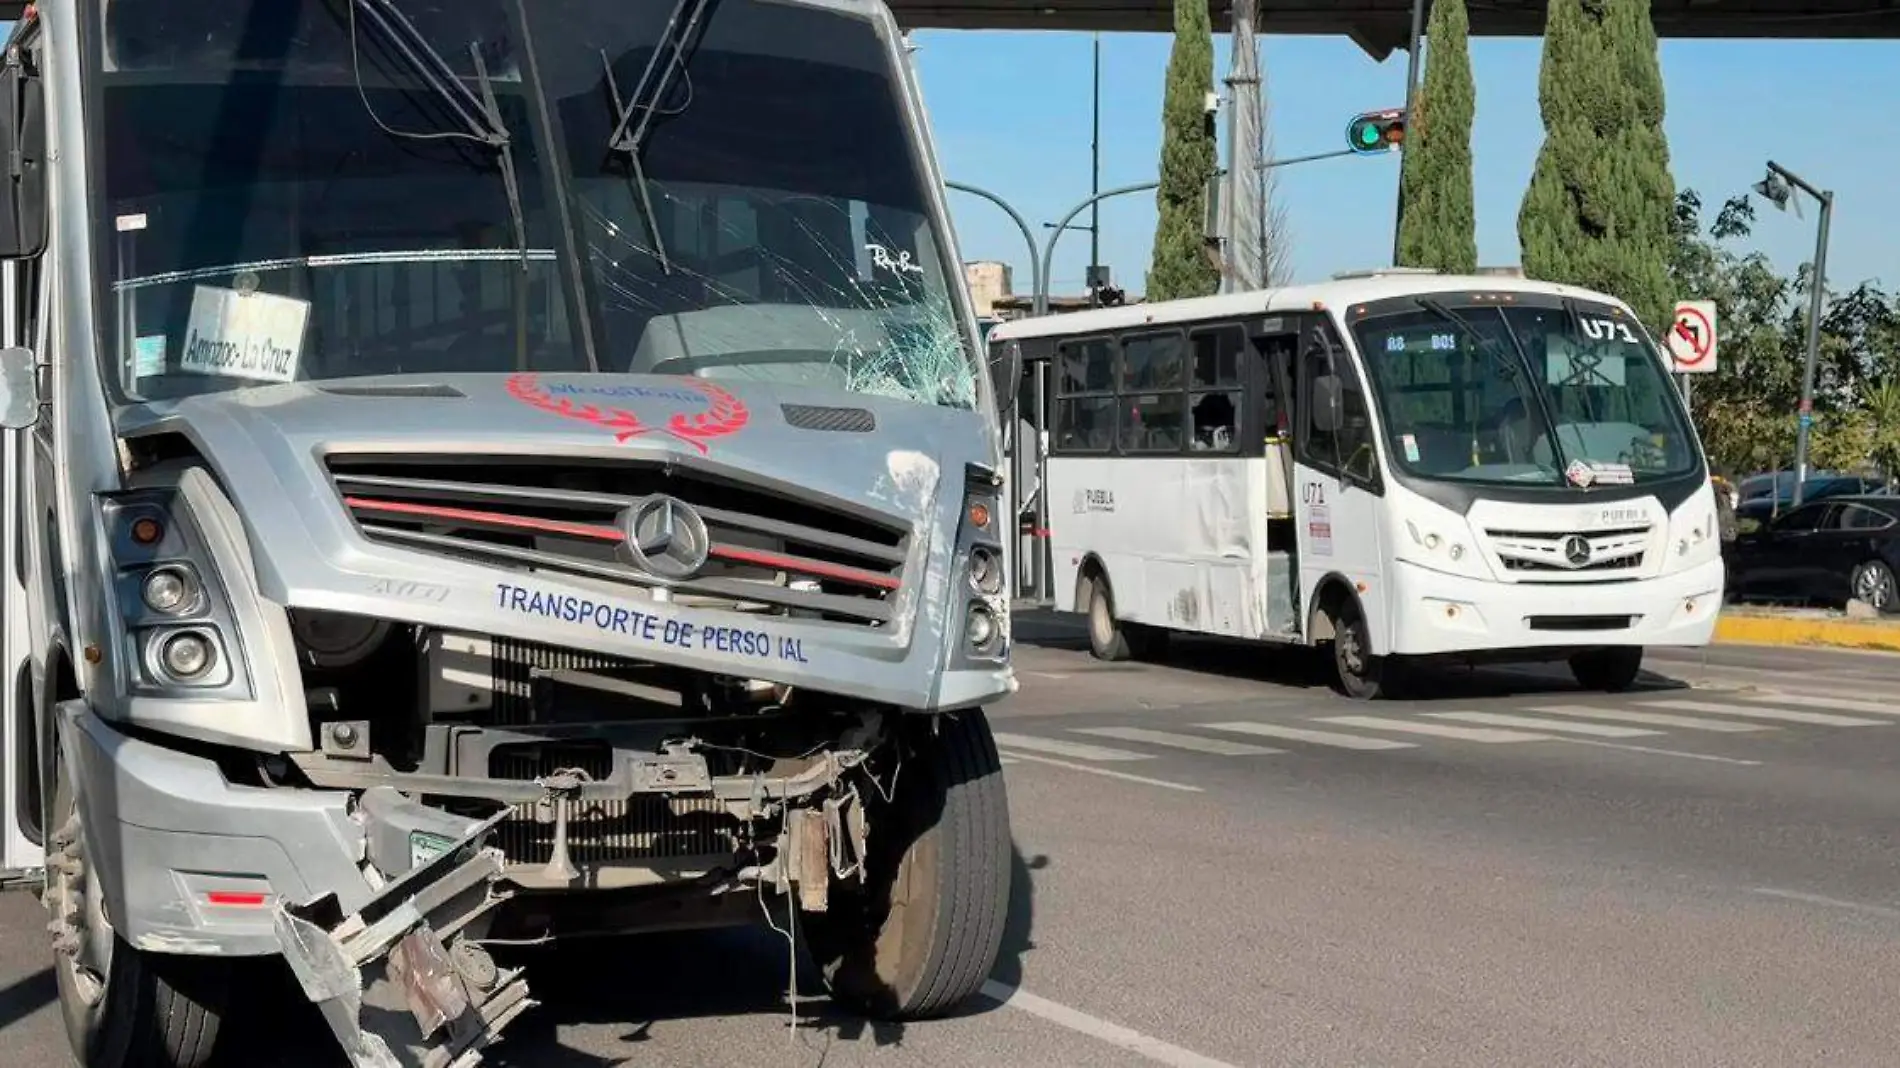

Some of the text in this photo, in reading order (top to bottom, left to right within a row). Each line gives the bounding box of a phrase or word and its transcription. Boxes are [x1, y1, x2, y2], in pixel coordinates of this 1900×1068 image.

[1581, 318, 1640, 343] U71
[261, 337, 292, 375] Cruz
[1302, 482, 1325, 504] U71
[497, 584, 659, 640] TRANSPORTE
[663, 619, 694, 649] DE
